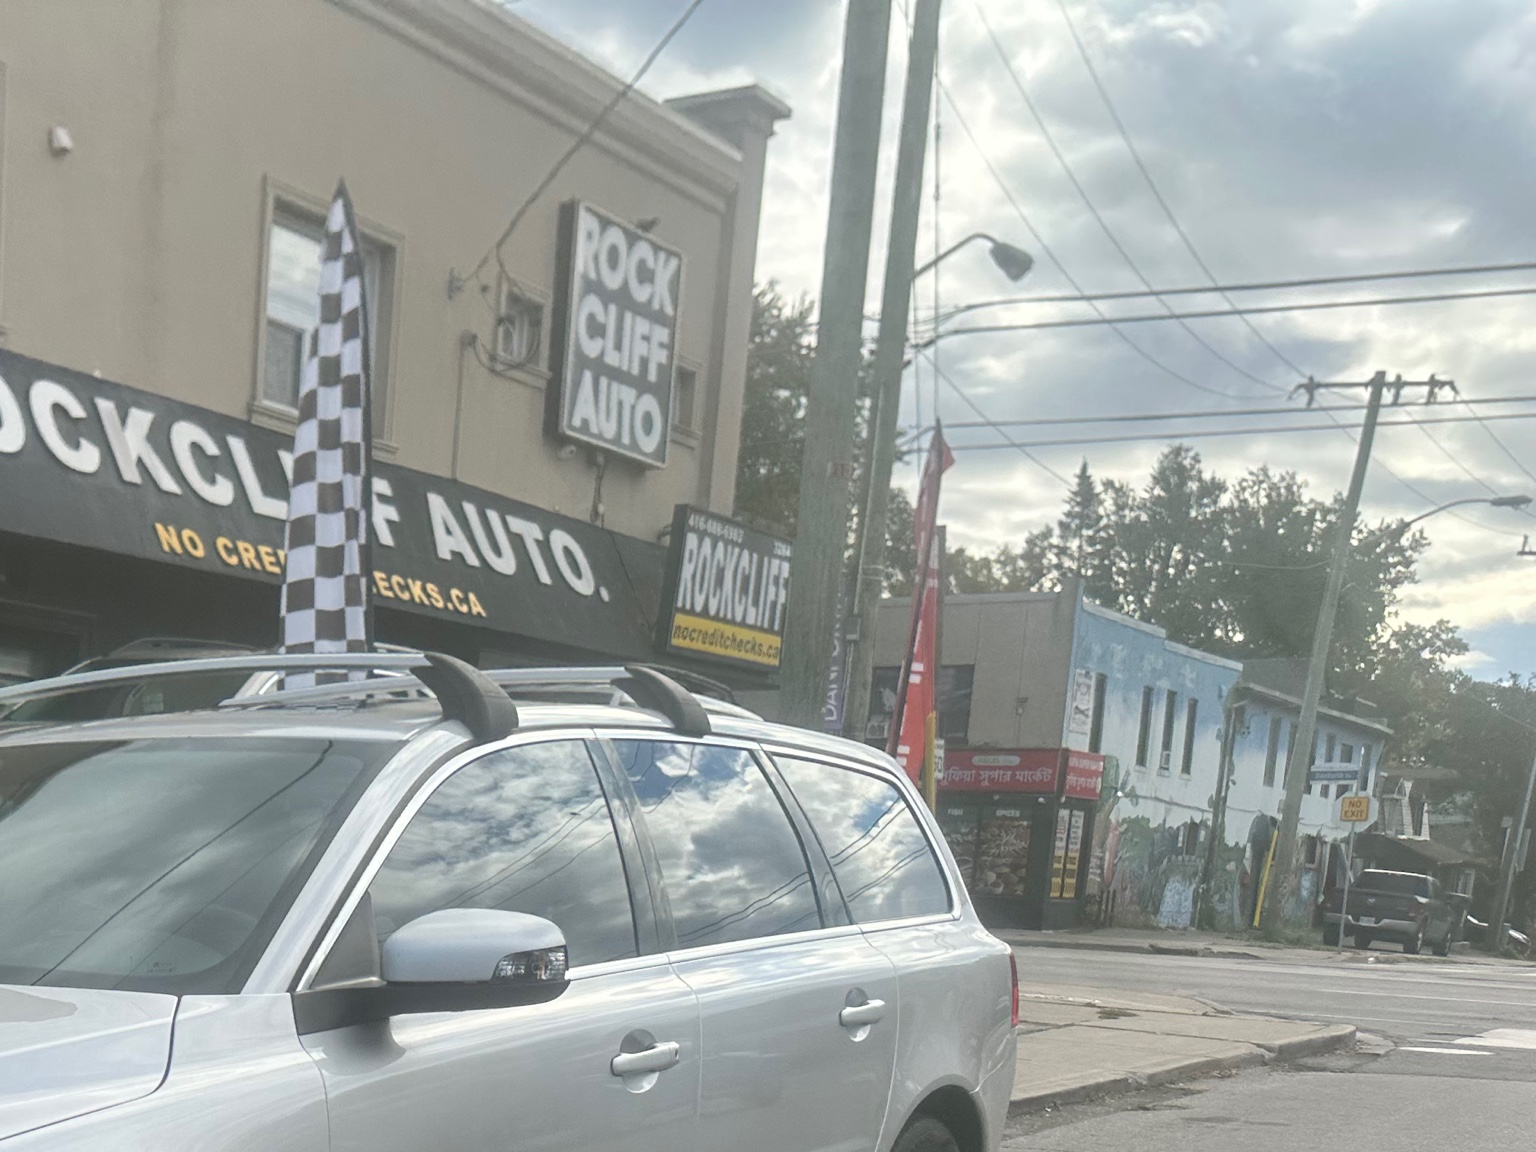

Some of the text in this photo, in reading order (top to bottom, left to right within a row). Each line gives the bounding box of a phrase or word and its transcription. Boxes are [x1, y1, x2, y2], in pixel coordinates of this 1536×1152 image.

[579, 209, 680, 316] ROCK
[577, 293, 670, 383] CLIFF
[571, 369, 662, 454] AUTO
[154, 522, 205, 560] NO
[426, 491, 610, 603] AUTO.
[676, 531, 791, 632] ROCKCLIFF
[672, 624, 780, 660] nocreditchecks.ca
[1344, 810, 1364, 818] EXIT
[1348, 800, 1362, 809] NO
